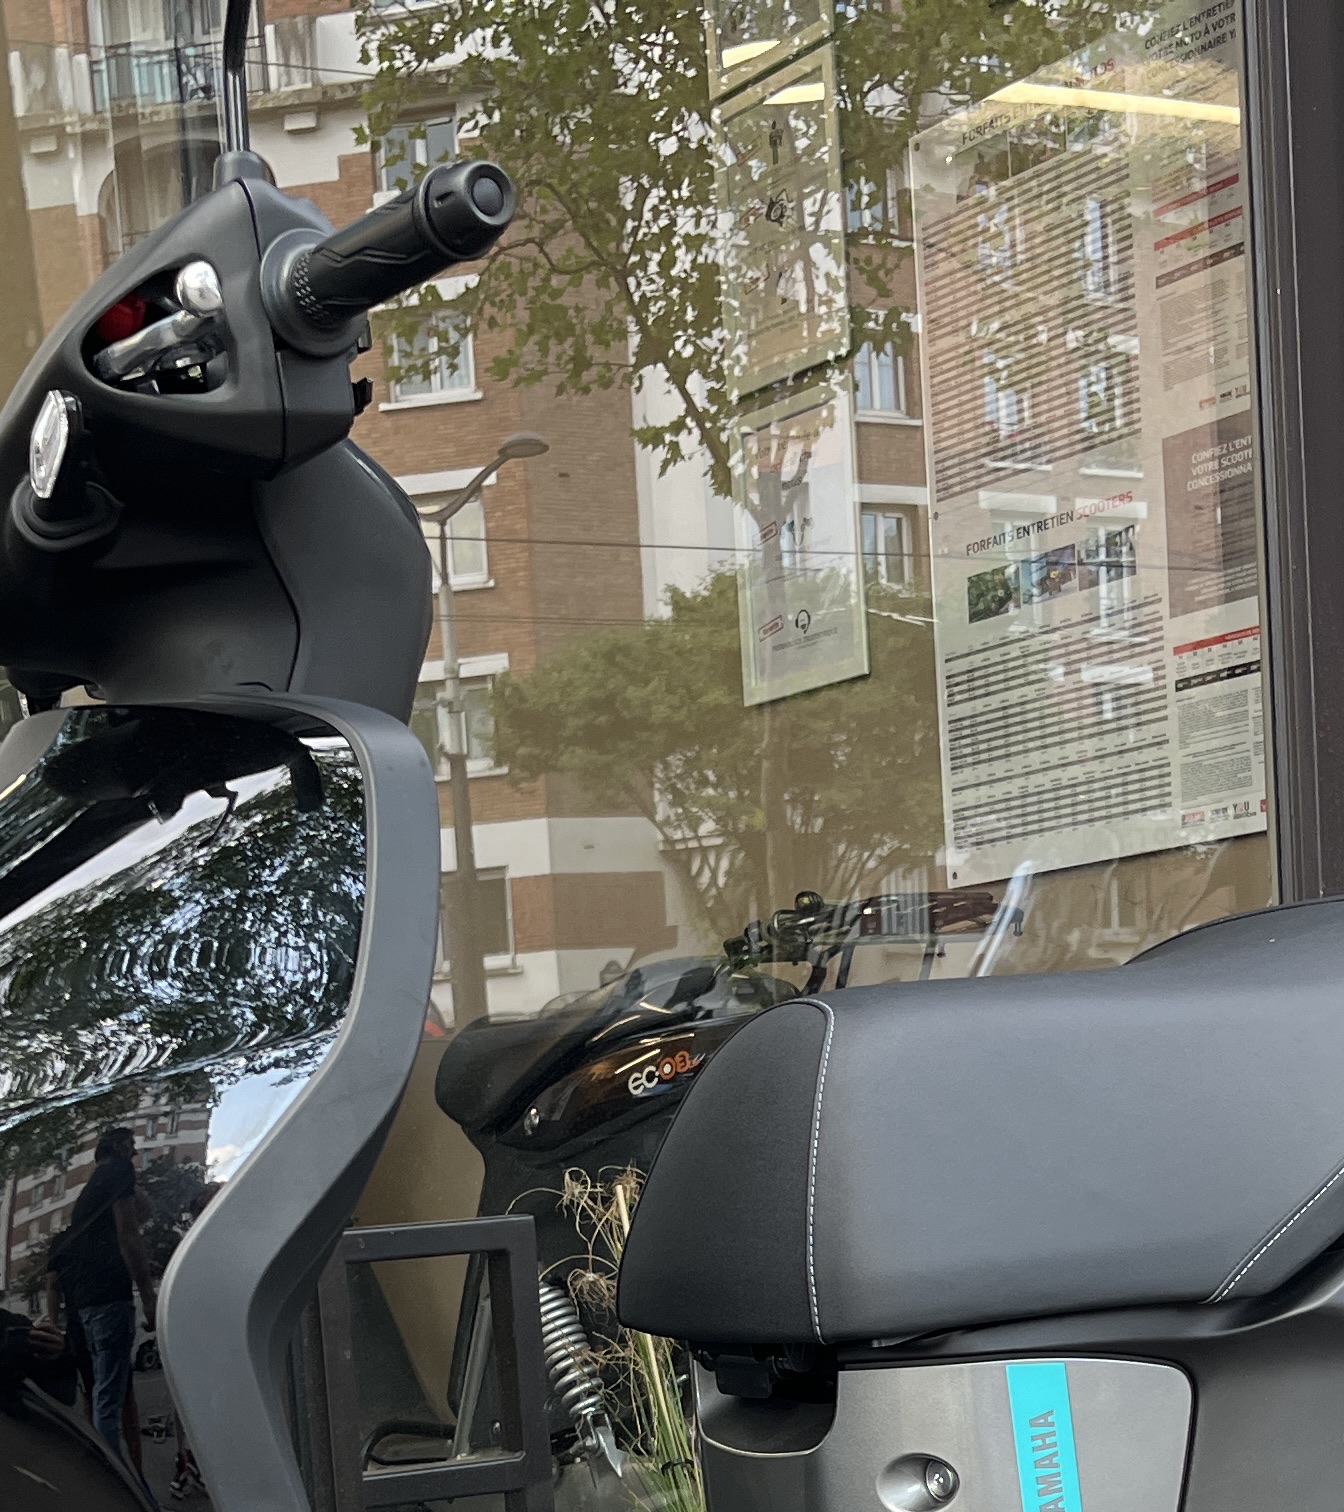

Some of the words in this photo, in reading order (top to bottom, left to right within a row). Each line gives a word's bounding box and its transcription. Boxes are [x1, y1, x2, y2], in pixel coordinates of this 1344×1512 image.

[1181, 1, 1236, 33] L'ENTRETIE
[1185, 462, 1254, 492] CONCESSIONNA
[1190, 457, 1220, 477] VOTRE
[965, 531, 1015, 557] FORFAITS
[1015, 510, 1074, 541] ENTRETIEN
[1075, 490, 1134, 521] SCOOTERS
